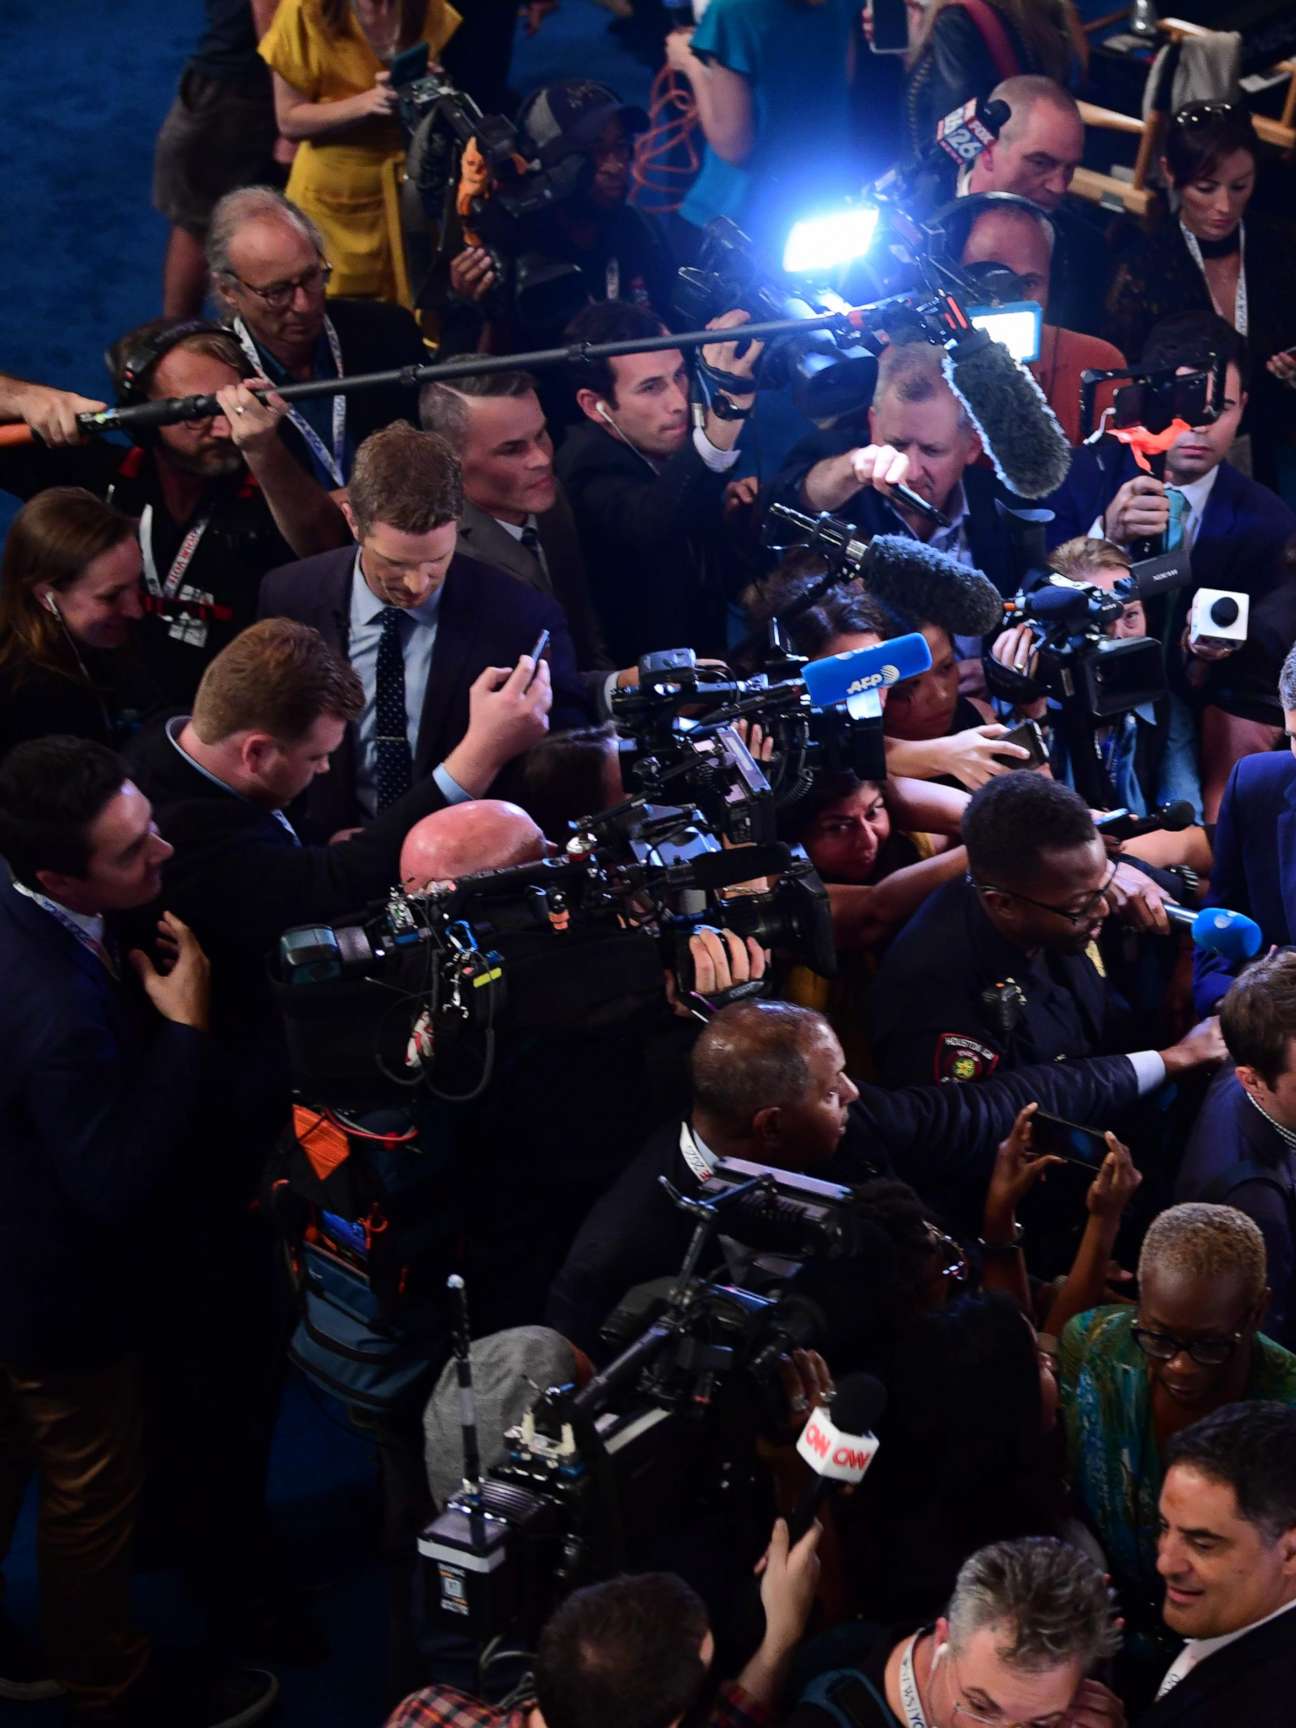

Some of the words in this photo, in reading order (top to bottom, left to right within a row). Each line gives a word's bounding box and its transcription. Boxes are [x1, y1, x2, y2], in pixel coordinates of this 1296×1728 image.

[944, 128, 983, 159] 26
[967, 119, 995, 145] FOX
[846, 673, 883, 694] AFP
[805, 1423, 832, 1459] CNN
[832, 1447, 871, 1471] CNN
